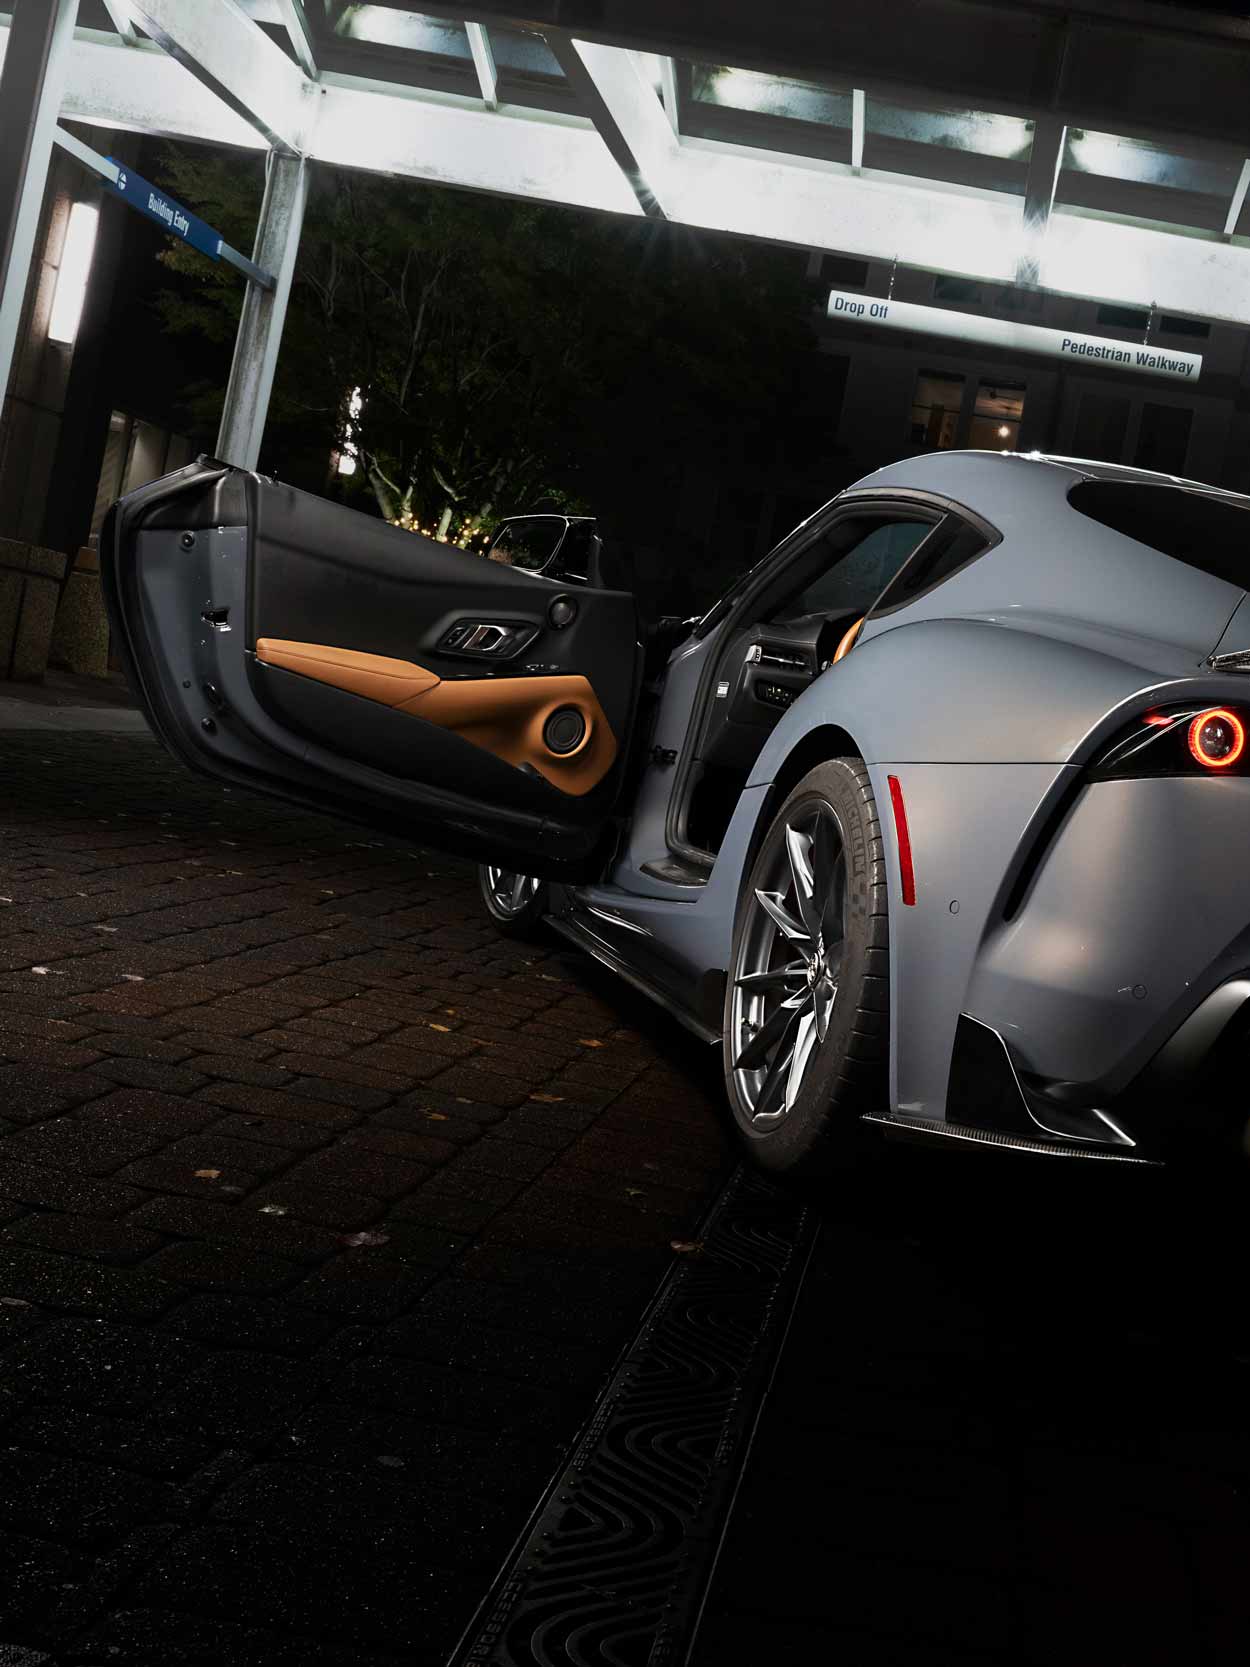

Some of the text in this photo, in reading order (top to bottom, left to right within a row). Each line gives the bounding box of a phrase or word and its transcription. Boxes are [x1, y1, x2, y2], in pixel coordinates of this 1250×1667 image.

[148, 192, 190, 237] Building Entry
[834, 297, 889, 319] Drop Off
[1061, 338, 1195, 377] Pedestrian Walkway
